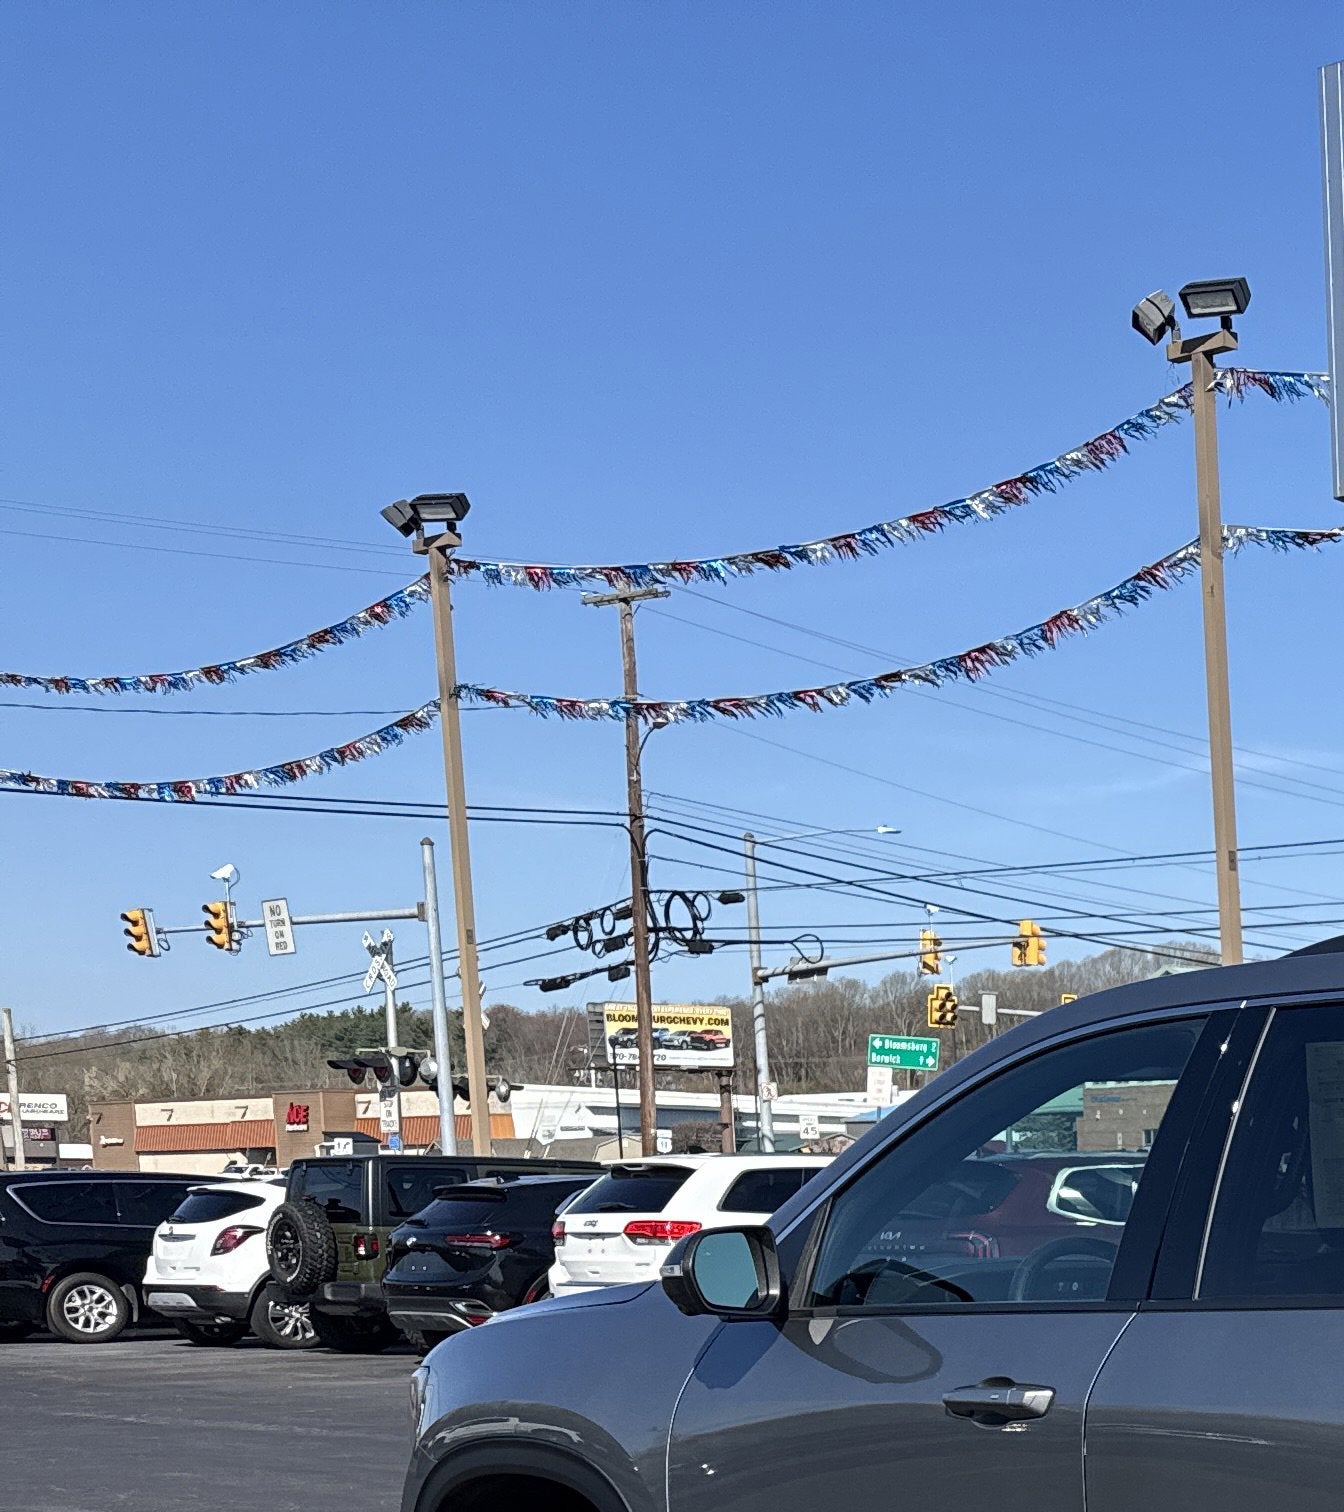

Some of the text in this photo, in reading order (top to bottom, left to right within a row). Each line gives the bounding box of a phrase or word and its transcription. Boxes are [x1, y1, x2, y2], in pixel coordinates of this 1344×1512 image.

[269, 904, 282, 917] NO
[274, 930, 285, 940] ON
[275, 940, 288, 951] RED
[606, 1013, 730, 1027] BLOOMURGCHEVY.COM
[285, 1103, 310, 1125] ACE
[802, 1126, 818, 1136] 45
